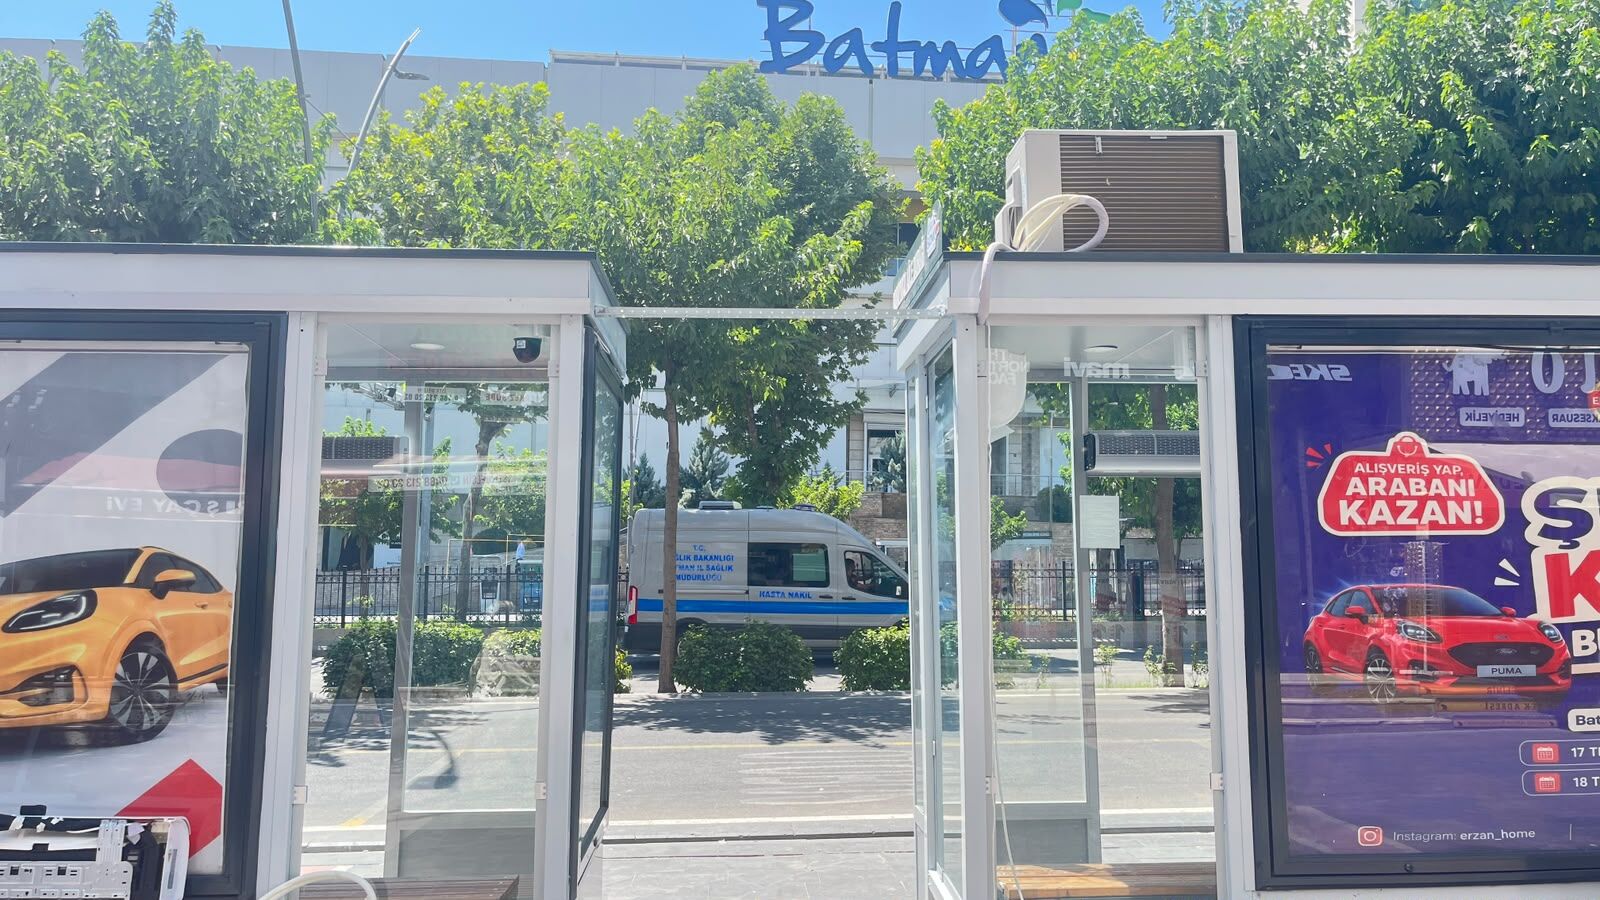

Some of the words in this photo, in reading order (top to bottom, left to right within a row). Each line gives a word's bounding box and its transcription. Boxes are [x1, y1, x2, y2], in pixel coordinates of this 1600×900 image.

[1353, 462, 1430, 477] ALIŞVERİŞ
[1433, 464, 1464, 477] YAP,
[1345, 477, 1476, 497] ARABANI
[1338, 500, 1485, 526] KAZAN!
[759, 591, 786, 599] HASTA
[1571, 628, 1600, 657] B
[1491, 667, 1523, 675] PUMA
[1571, 747, 1585, 757] 17
[1589, 747, 1600, 757] T
[1573, 777, 1588, 787] 18
[1393, 831, 1457, 843] Instagram:
[1460, 829, 1536, 841] erzan_home
